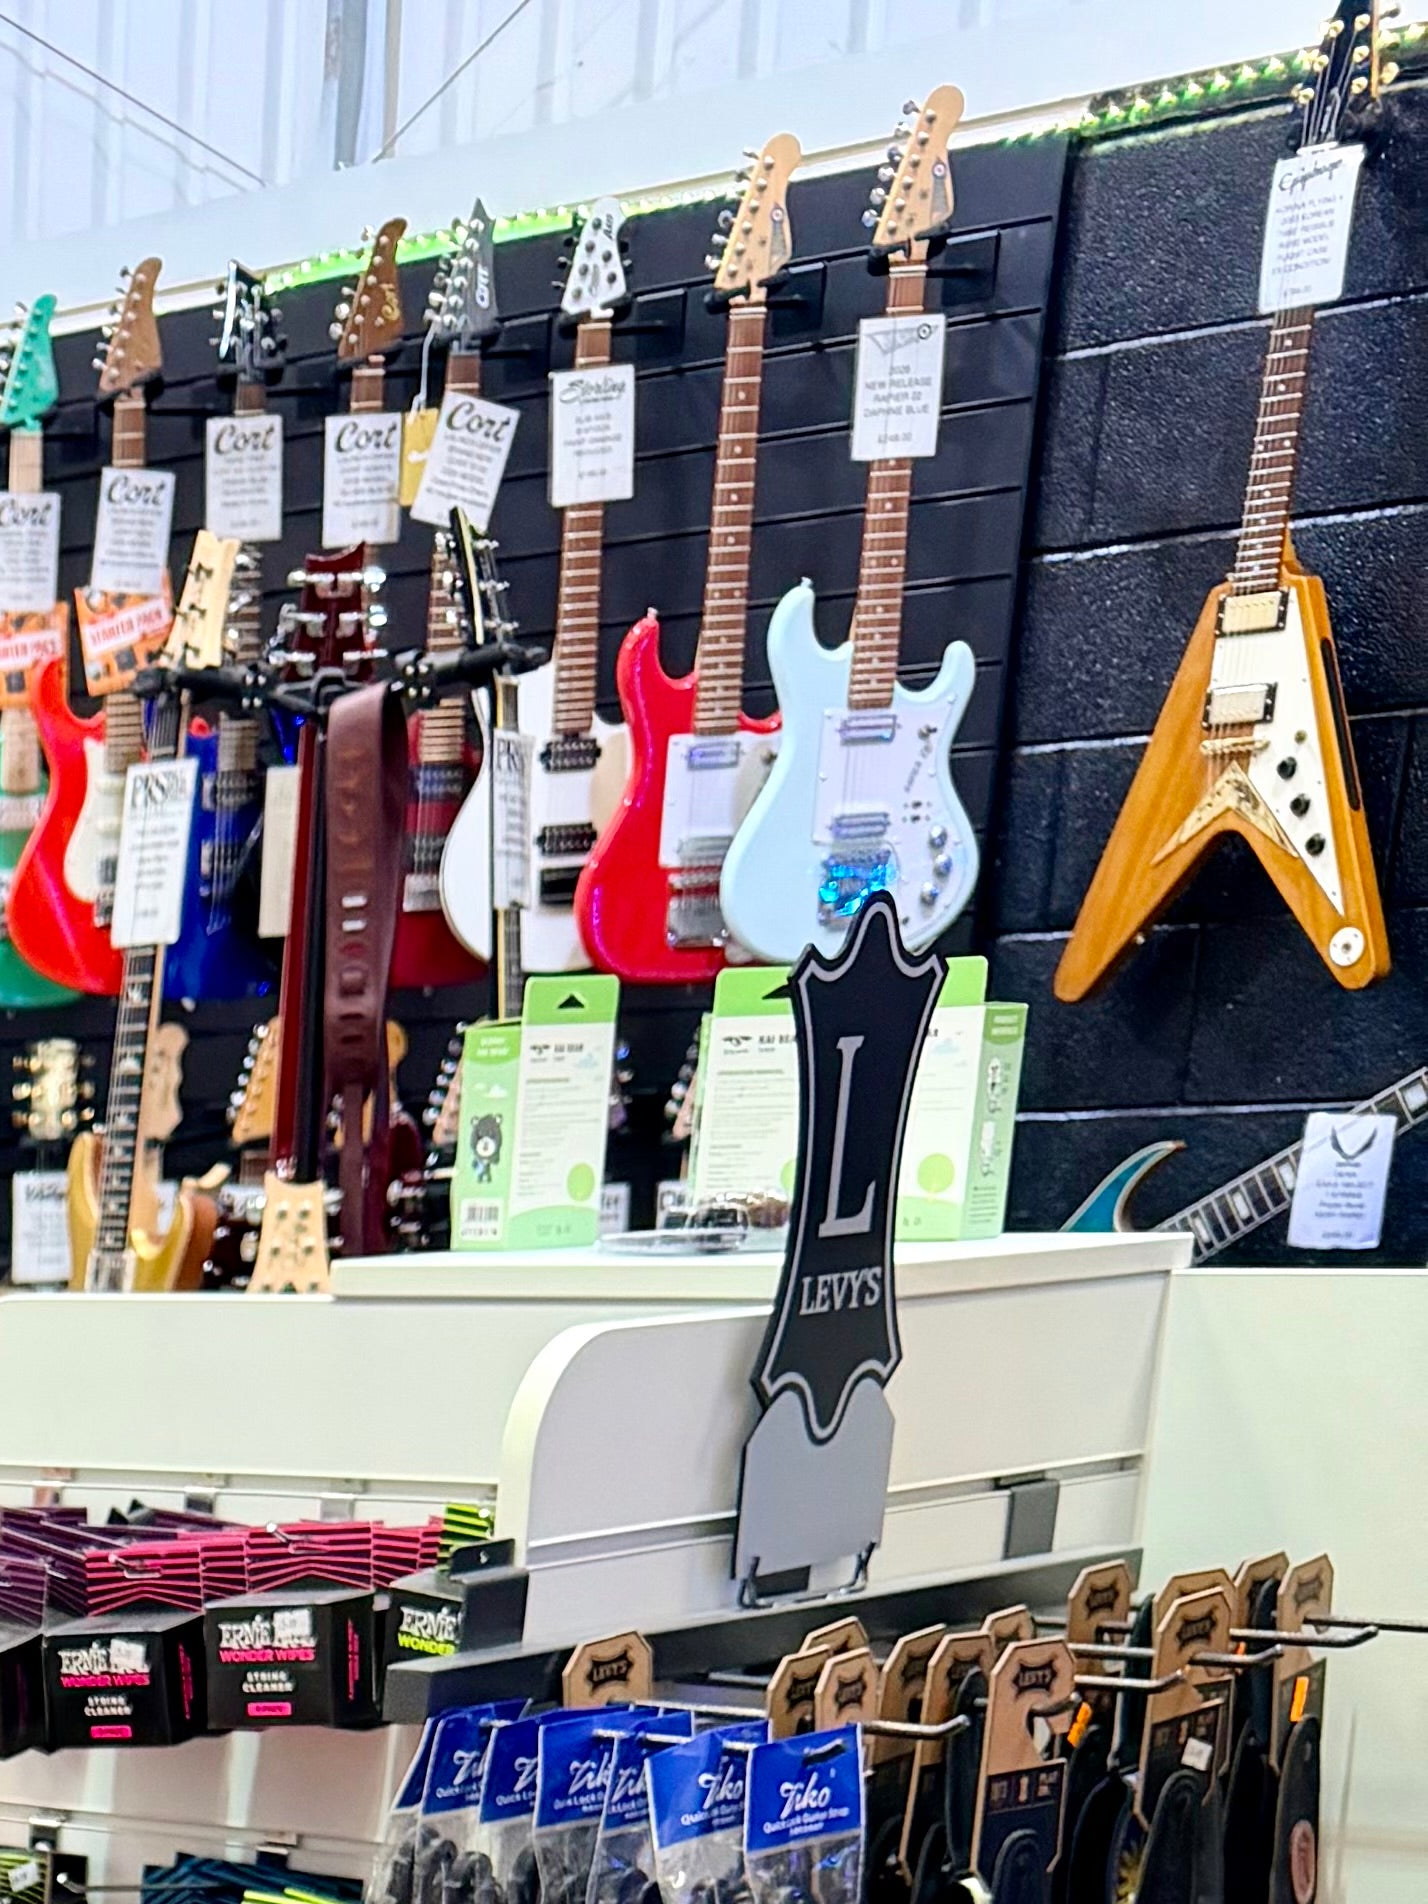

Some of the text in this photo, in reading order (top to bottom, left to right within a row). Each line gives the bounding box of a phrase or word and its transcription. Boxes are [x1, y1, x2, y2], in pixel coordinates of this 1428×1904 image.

[334, 420, 398, 454] Cort
[445, 400, 512, 443] Cort
[213, 424, 276, 456] Cort
[107, 474, 166, 506] Cort
[798, 1265, 884, 1317] LEVY'S
[217, 1613, 271, 1650] ERNIE
[399, 1604, 457, 1642] ERNIE
[57, 1638, 108, 1675] ERNIE
[219, 1648, 316, 1664] WONDER WIPES
[397, 1631, 457, 1656] WONDER
[59, 1673, 112, 1688] WONDER
